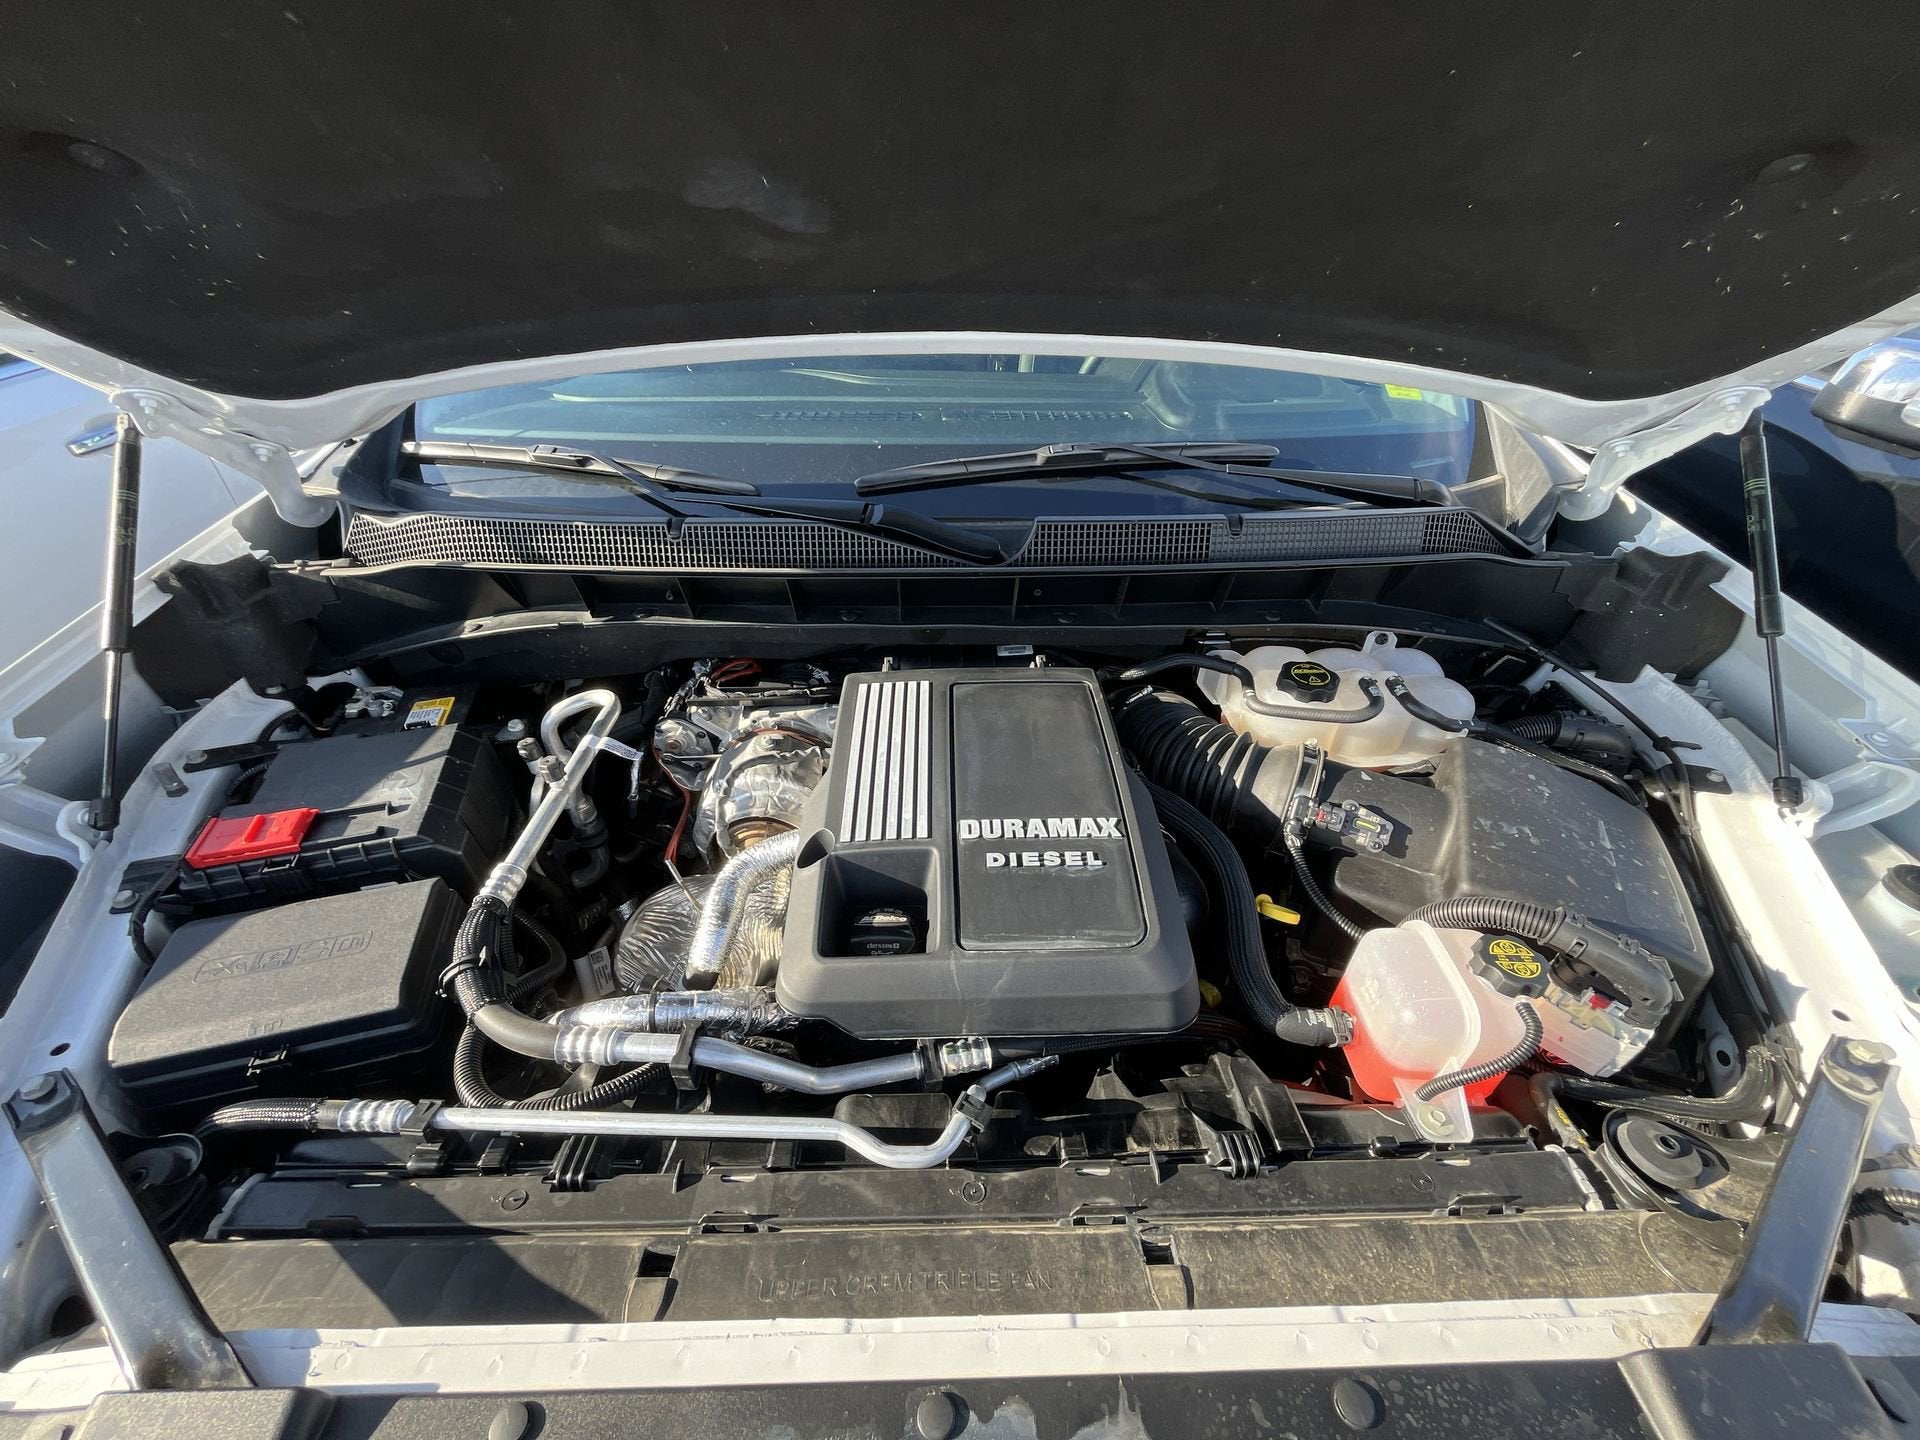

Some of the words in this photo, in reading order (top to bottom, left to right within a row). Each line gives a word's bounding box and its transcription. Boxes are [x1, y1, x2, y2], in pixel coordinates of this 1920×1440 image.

[959, 817, 1124, 839] DURAMAX
[986, 851, 1104, 867] DIESEL
[758, 1277, 837, 1302] UPPER
[919, 1269, 1002, 1292] TRIPLE
[1008, 1269, 1053, 1292] FAN
